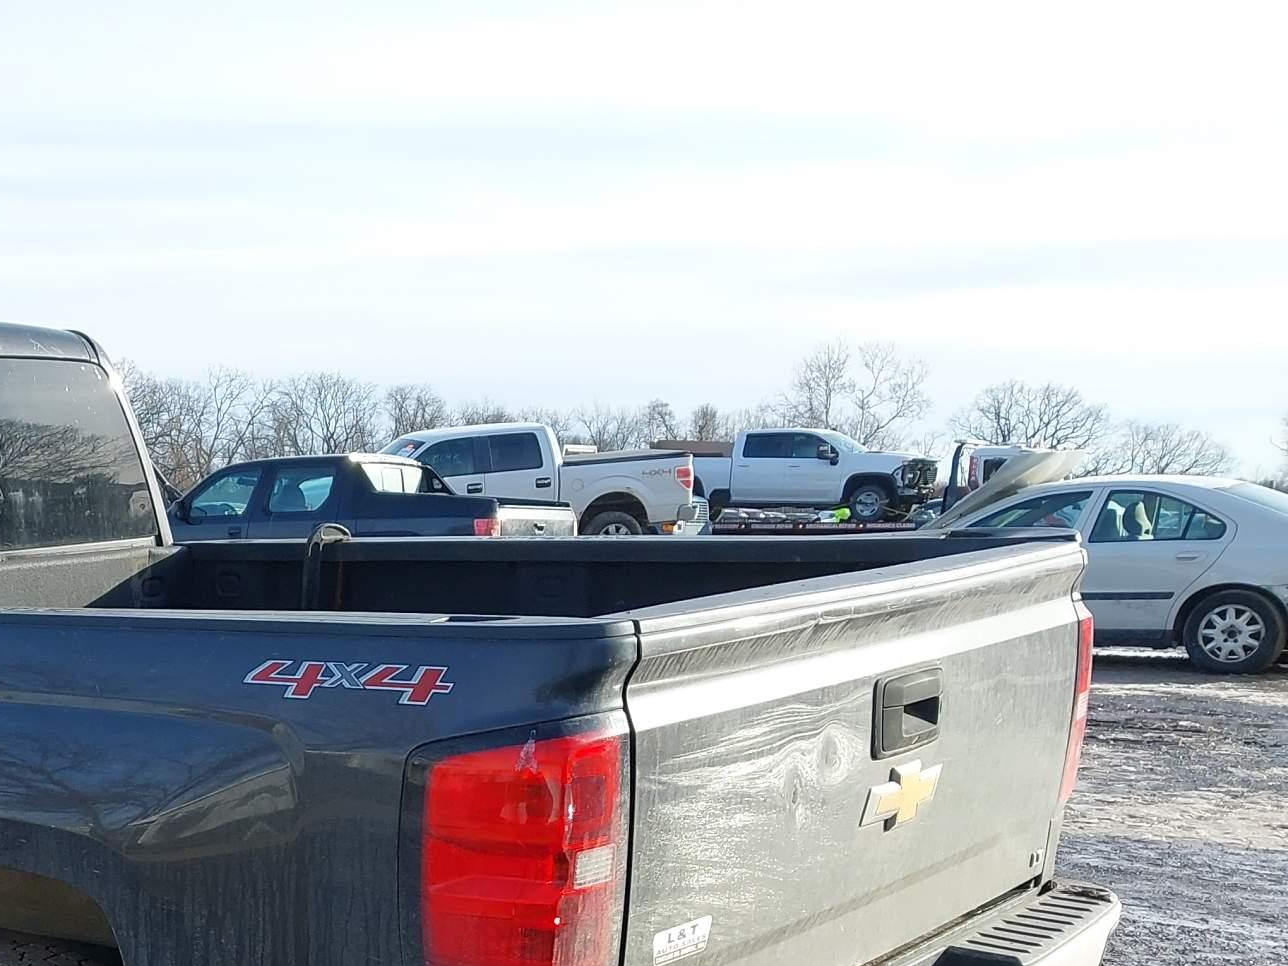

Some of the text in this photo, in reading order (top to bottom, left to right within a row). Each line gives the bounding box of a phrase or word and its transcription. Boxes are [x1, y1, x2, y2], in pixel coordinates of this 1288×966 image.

[667, 923, 699, 944] L & T
[655, 943, 679, 956] AUTO
